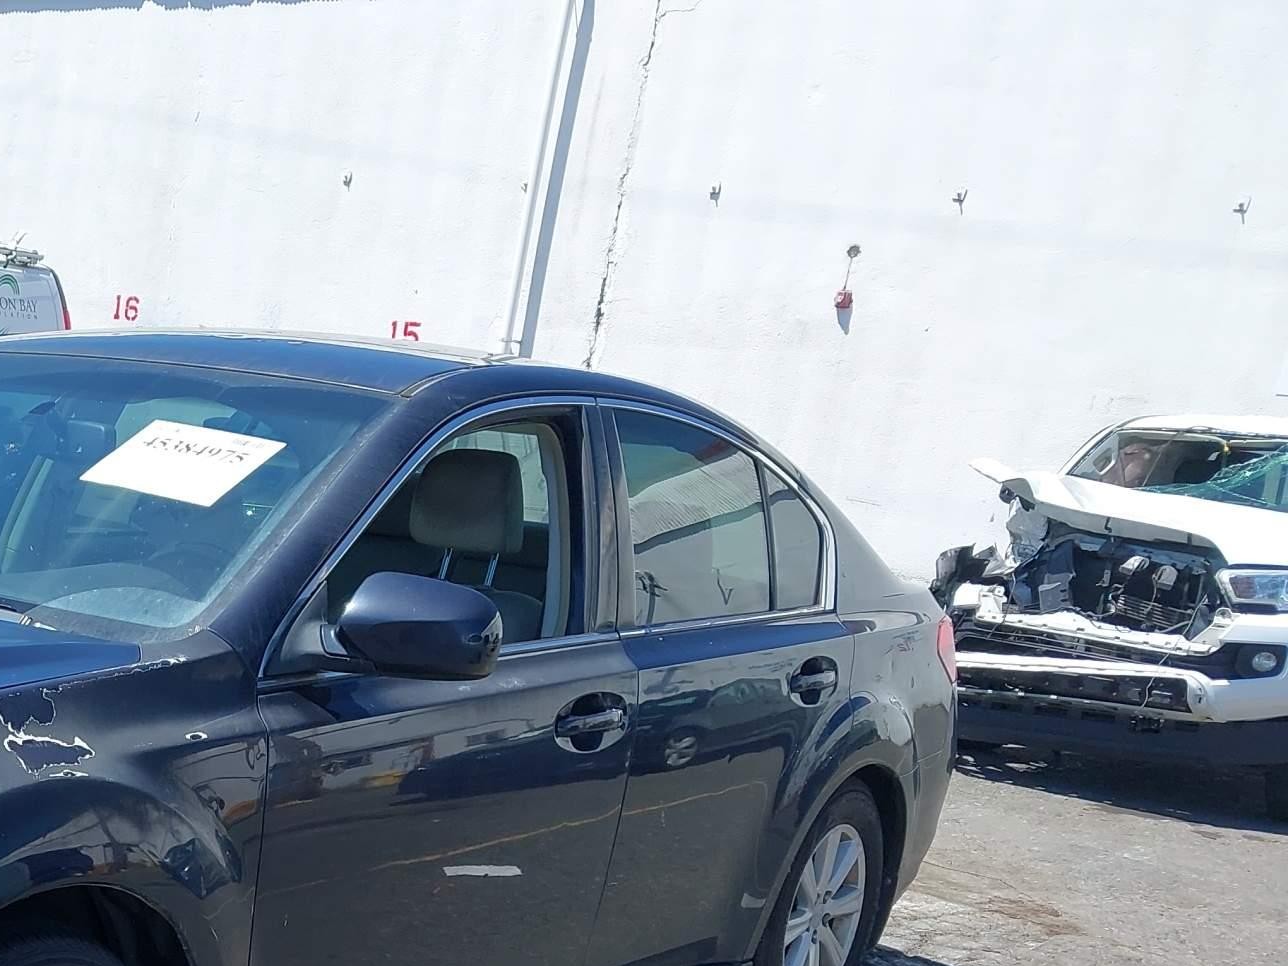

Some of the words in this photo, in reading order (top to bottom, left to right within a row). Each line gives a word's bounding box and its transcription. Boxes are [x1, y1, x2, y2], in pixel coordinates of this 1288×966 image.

[19, 298, 38, 312] BAY
[113, 294, 140, 321] 16
[390, 320, 422, 342] 15
[143, 436, 249, 463] 45384975
